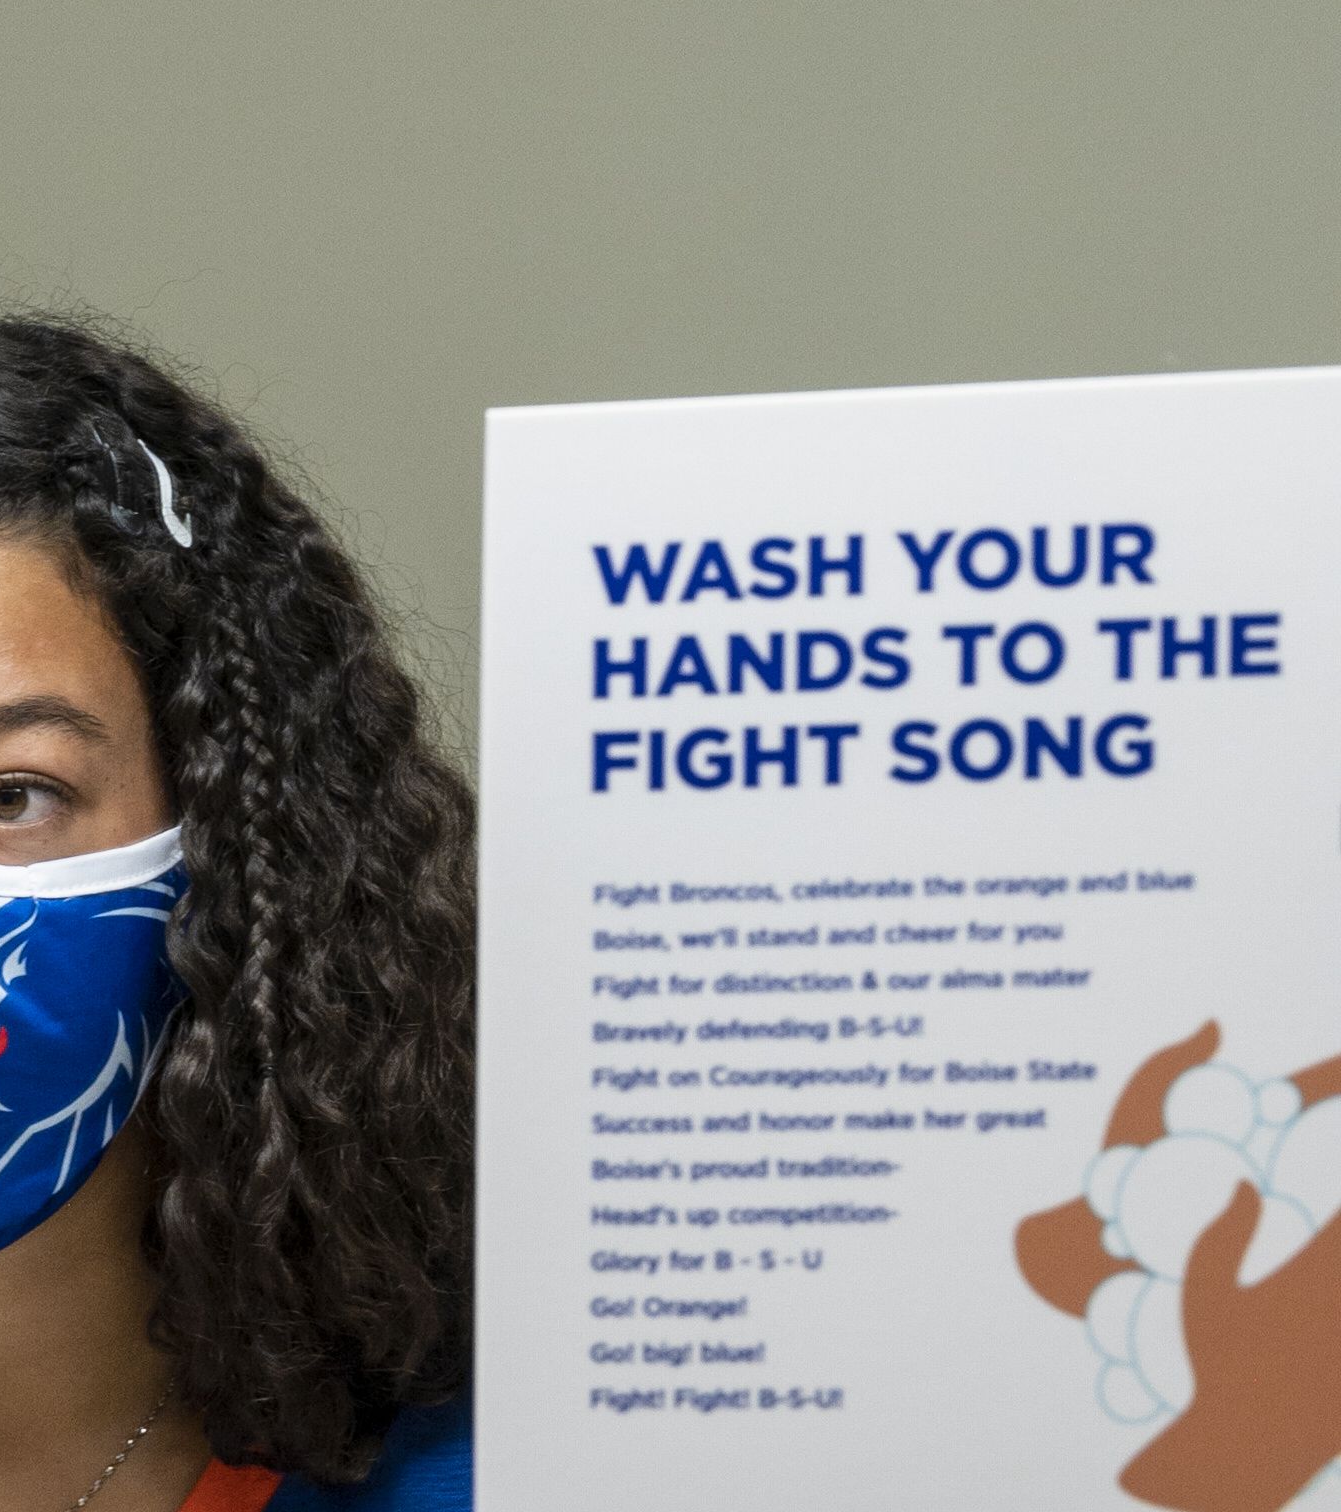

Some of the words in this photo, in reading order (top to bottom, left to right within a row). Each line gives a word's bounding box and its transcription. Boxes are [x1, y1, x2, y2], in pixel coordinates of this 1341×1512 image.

[593, 535, 864, 605] WASH
[897, 524, 1156, 592] YOUR
[593, 627, 911, 698] HANDS
[942, 621, 1066, 685] TO
[1097, 613, 1281, 680] THE
[592, 724, 860, 792] FIGHT
[889, 714, 1154, 783] SONG
[592, 884, 661, 910] Fight
[790, 878, 916, 901] celebrate
[922, 876, 968, 898] the
[973, 877, 1071, 899] orange
[1076, 871, 1130, 894] and
[1135, 871, 1198, 893] blue
[745, 926, 821, 948] stand
[825, 924, 878, 947] and
[883, 924, 959, 945] cheer
[965, 921, 1006, 943] for
[1013, 924, 1065, 946] you
[591, 975, 661, 1002] Fight
[667, 974, 706, 996] for
[711, 972, 855, 995] distinction
[859, 969, 880, 993] &
[885, 974, 932, 992] our
[939, 969, 1006, 991] alma
[1011, 968, 1092, 989] mater
[591, 1021, 689, 1045] Bravely
[694, 1018, 832, 1044] defending
[590, 1067, 661, 1093] Fight
[666, 1070, 702, 1089] on
[708, 1064, 891, 1090] Courageously
[897, 1062, 937, 1085] for
[943, 1061, 1020, 1085] Boise
[1026, 1060, 1099, 1083] State
[591, 1113, 695, 1136] Success
[700, 1112, 753, 1134] and
[757, 1112, 837, 1133] honor
[842, 1110, 918, 1132] make
[922, 1109, 967, 1130] her
[974, 1109, 1047, 1134] great
[688, 1158, 771, 1183] proud
[684, 1208, 722, 1229] up
[589, 1250, 663, 1276] Glory
[667, 1250, 706, 1273] for
[713, 1249, 734, 1273] B
[758, 1249, 777, 1272] S
[801, 1250, 824, 1272] U
